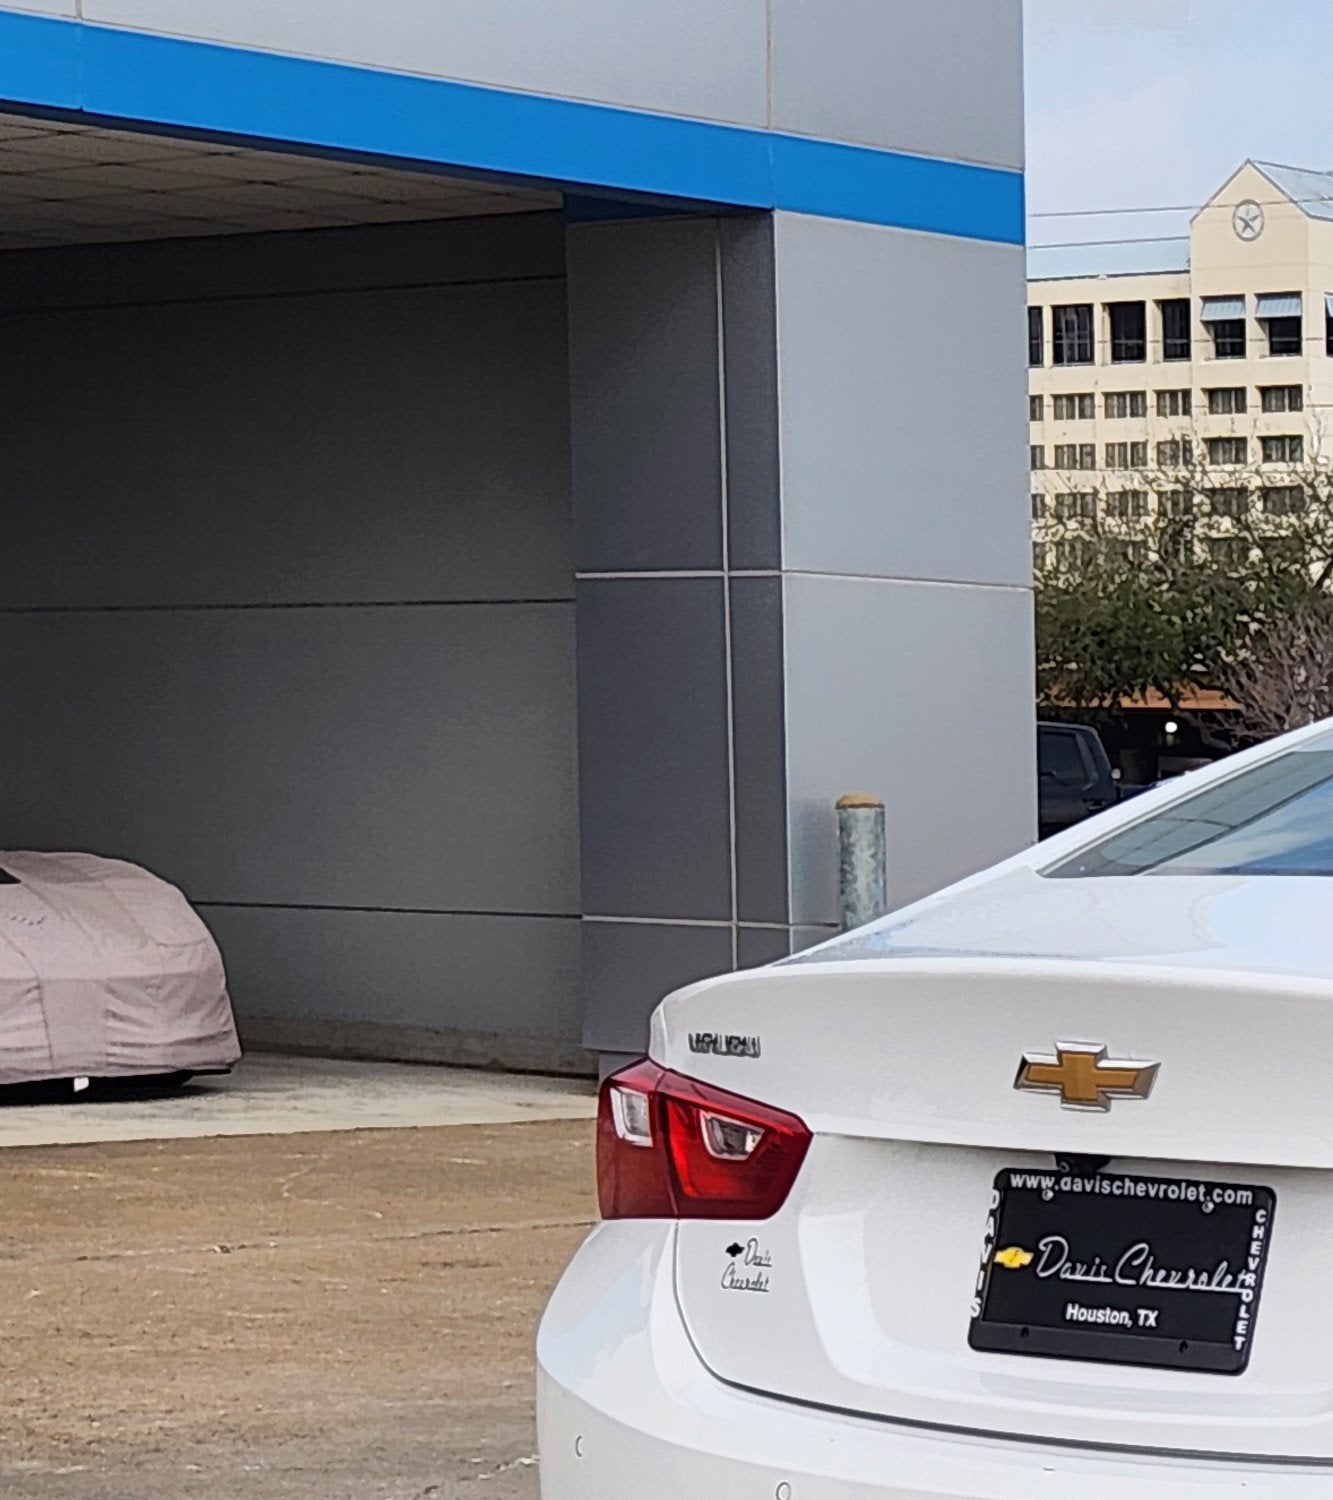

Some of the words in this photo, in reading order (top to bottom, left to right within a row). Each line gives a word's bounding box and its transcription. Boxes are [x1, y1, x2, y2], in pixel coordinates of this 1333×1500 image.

[1009, 1172, 1254, 1206] www.davischevrolet.com
[1035, 1235, 1113, 1284] Davis
[1114, 1242, 1249, 1293] Chevrolet
[1232, 1208, 1268, 1351] CHEVROLET
[1065, 1302, 1134, 1329] Houston,
[1136, 1308, 1160, 1328] TX
